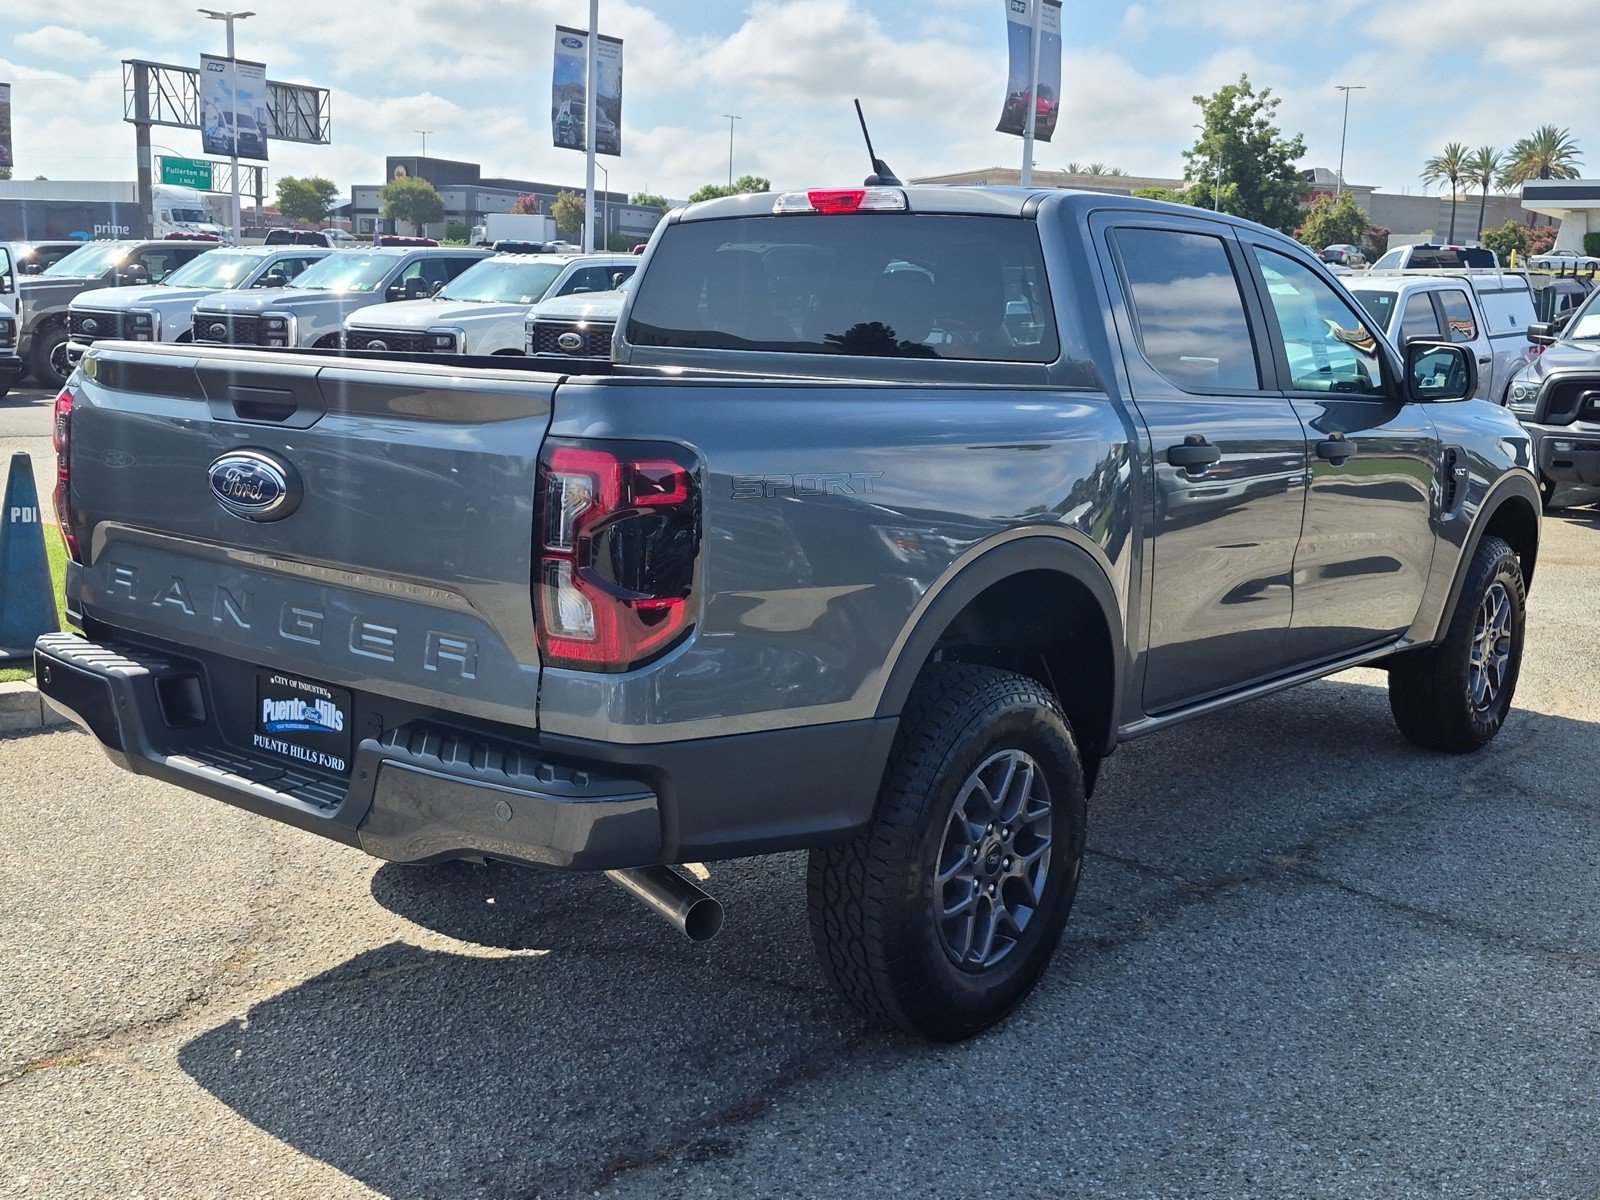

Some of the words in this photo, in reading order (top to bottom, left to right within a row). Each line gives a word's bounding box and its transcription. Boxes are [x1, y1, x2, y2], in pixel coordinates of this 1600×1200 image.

[564, 38, 580, 48] Ford
[165, 167, 197, 176] Fullerton
[94, 222, 130, 237] prime
[1454, 468, 1467, 476] XLT
[222, 467, 263, 501] Ford
[731, 471, 885, 499] SPORT
[10, 506, 38, 523] PDI
[105, 561, 479, 680] RANGER
[274, 675, 288, 686] CITY
[289, 679, 297, 688] OF
[298, 681, 328, 696] INDUSTRY
[263, 698, 307, 723] Puente
[315, 698, 344, 732] Hills
[253, 734, 289, 755] PUENTE
[290, 745, 318, 763] HILLS
[319, 754, 345, 771] FORD
